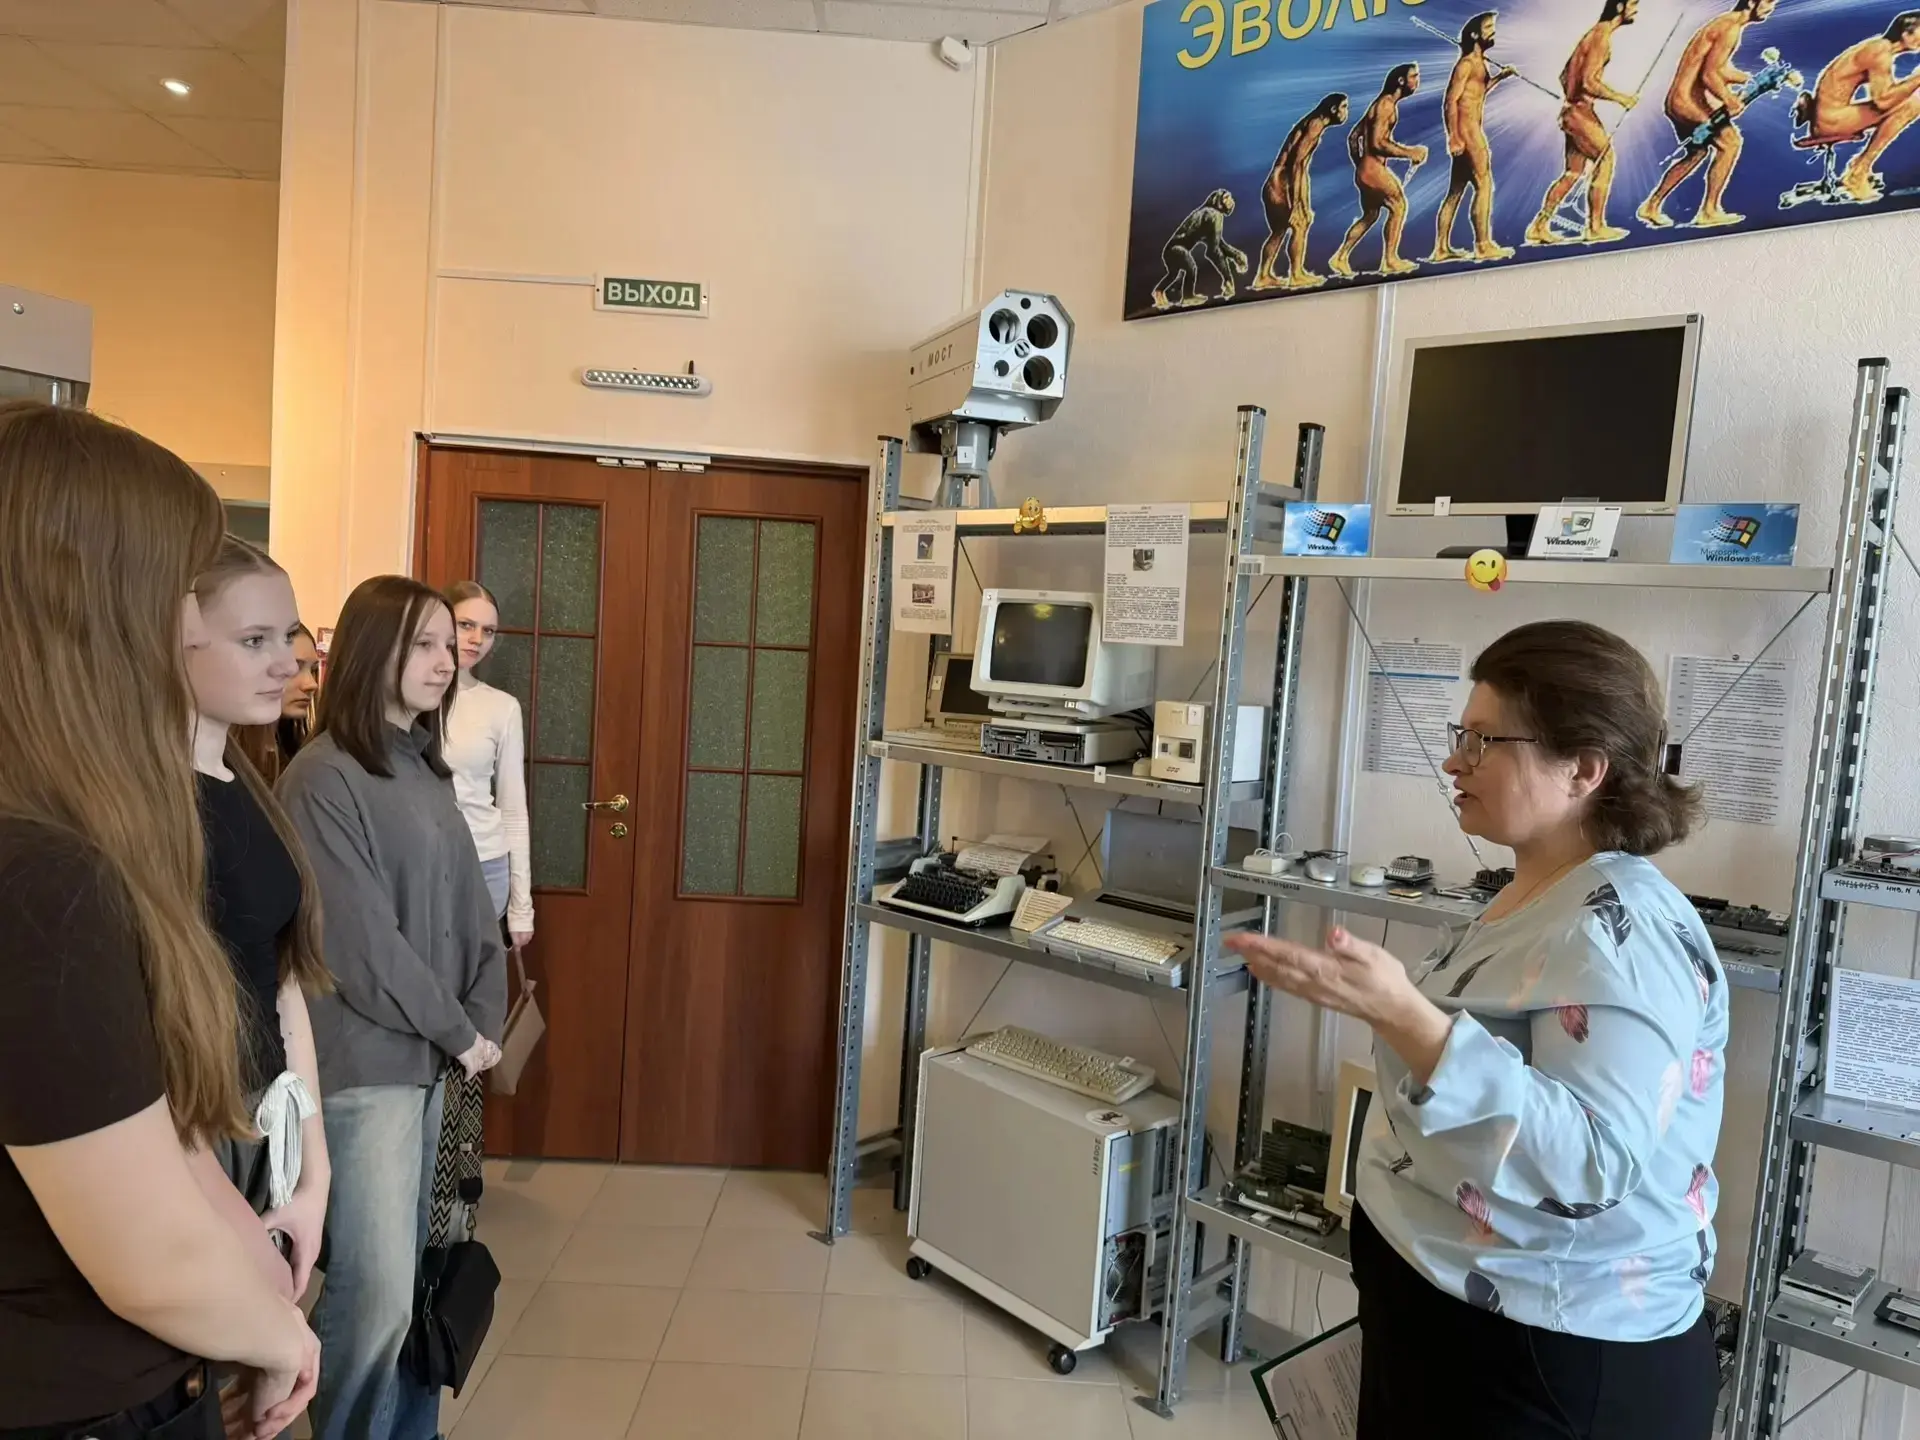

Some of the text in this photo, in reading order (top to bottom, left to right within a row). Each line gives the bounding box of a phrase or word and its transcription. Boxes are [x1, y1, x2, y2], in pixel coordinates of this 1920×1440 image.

[607, 282, 696, 307] ВЫХОД
[928, 344, 953, 368] МОСТ
[1546, 536, 1587, 546] Windows
[1307, 543, 1338, 551] Windows
[1700, 548, 1739, 556] Microsoft
[1706, 554, 1761, 563] Windows 98
